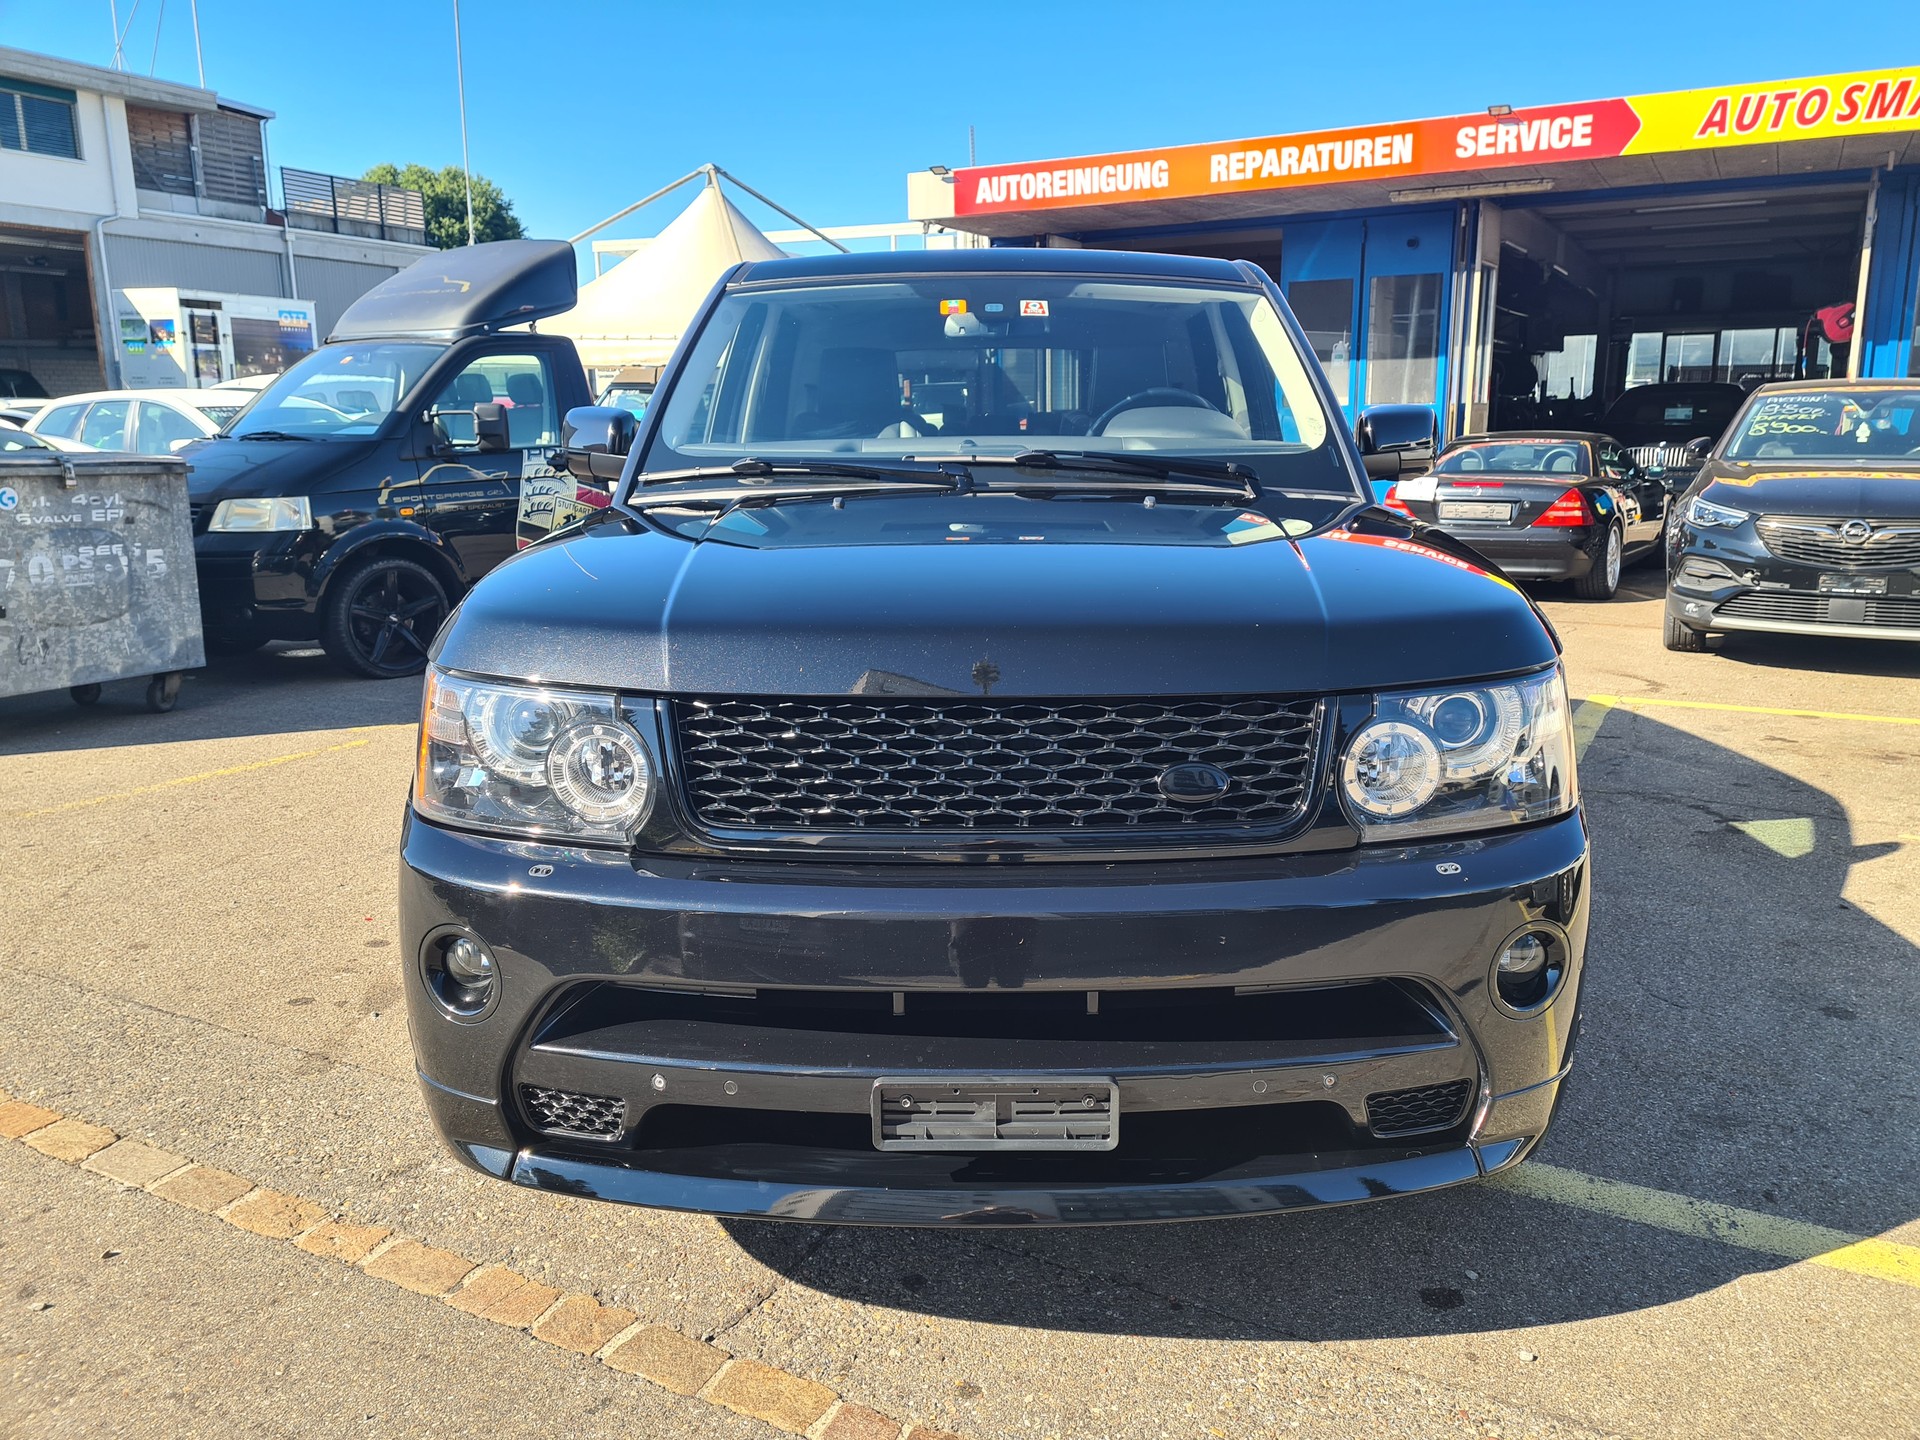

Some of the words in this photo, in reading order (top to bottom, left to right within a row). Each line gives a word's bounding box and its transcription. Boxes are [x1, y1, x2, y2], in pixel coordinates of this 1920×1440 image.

[1695, 86, 1831, 138] AUTO
[976, 160, 1168, 204] AUTOREINIGUNG
[1210, 133, 1413, 183] REPARATUREN
[1456, 114, 1593, 158] SERVICE
[393, 491, 484, 503] SPORTGARAGE
[557, 500, 591, 514] STUTTGART
